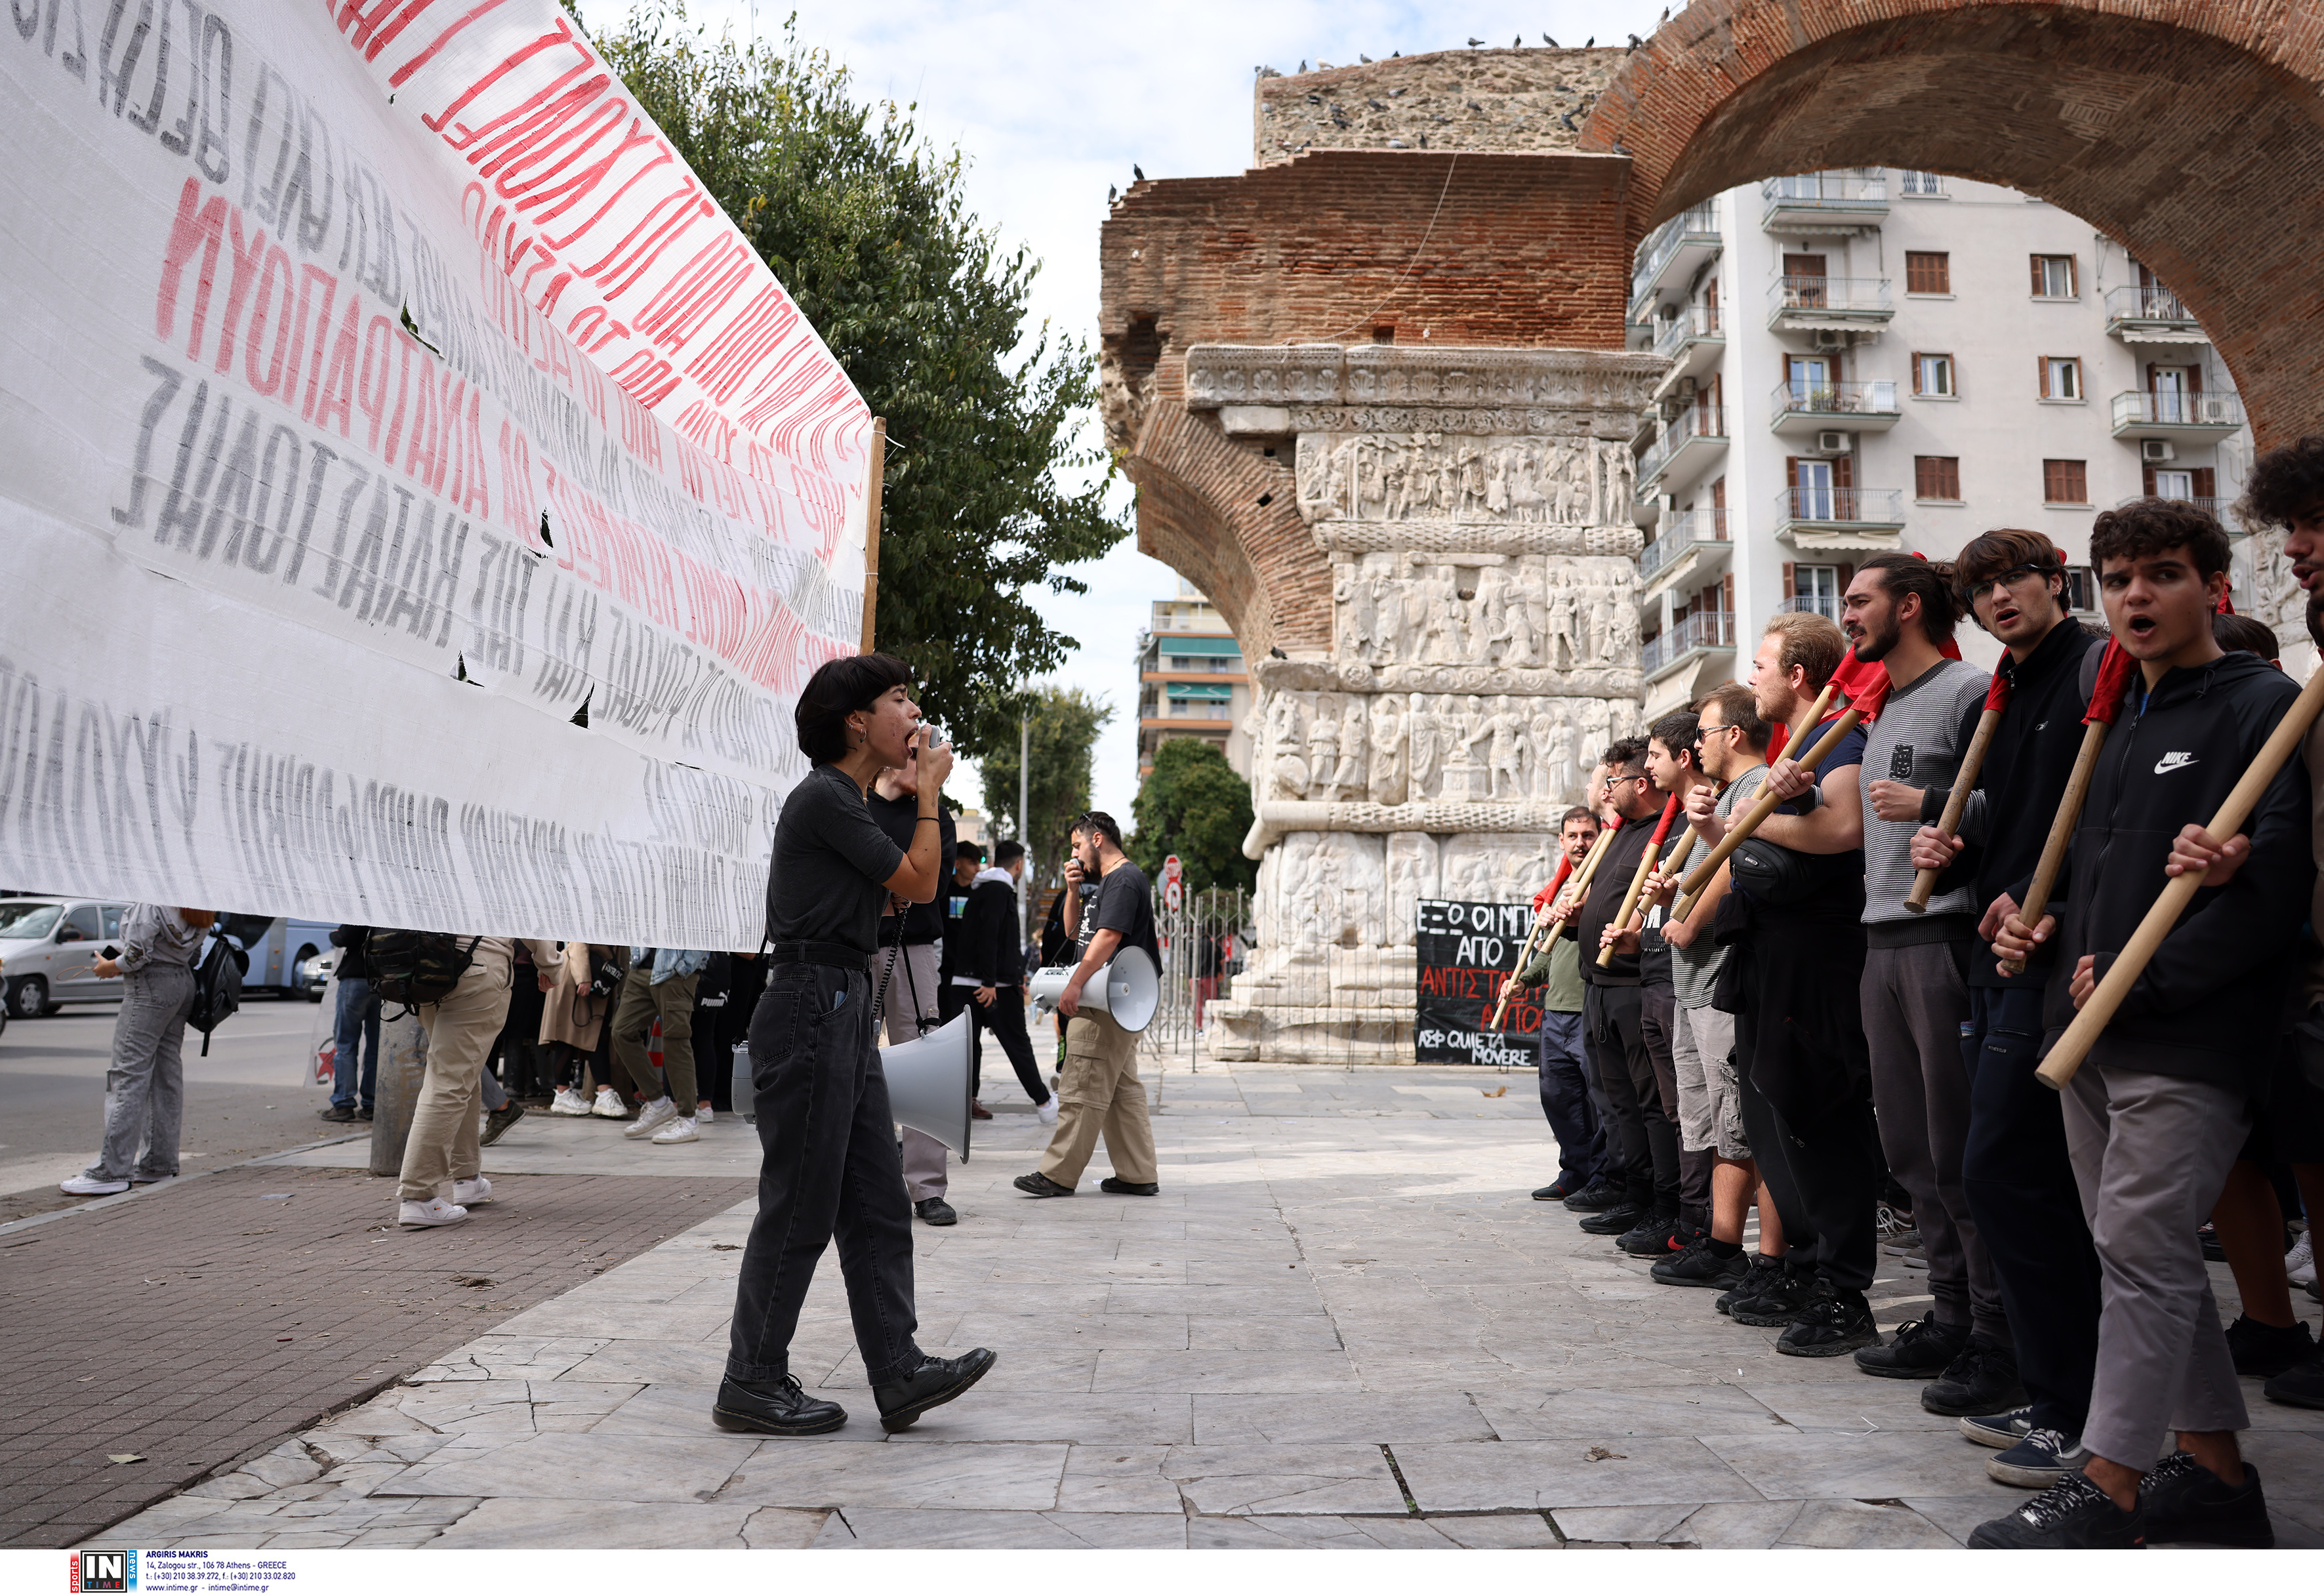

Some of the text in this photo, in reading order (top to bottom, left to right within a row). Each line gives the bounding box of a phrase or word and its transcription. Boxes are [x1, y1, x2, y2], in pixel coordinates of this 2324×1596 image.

[2161, 751, 2192, 764] NIKE
[1471, 905, 1495, 933] ΟΙ
[1456, 935, 1504, 967] ΑΠΟ
[701, 997, 725, 1008] PUMA
[1447, 1030, 1506, 1050] QUIETA
[1472, 1049, 1532, 1066] MOVERE
